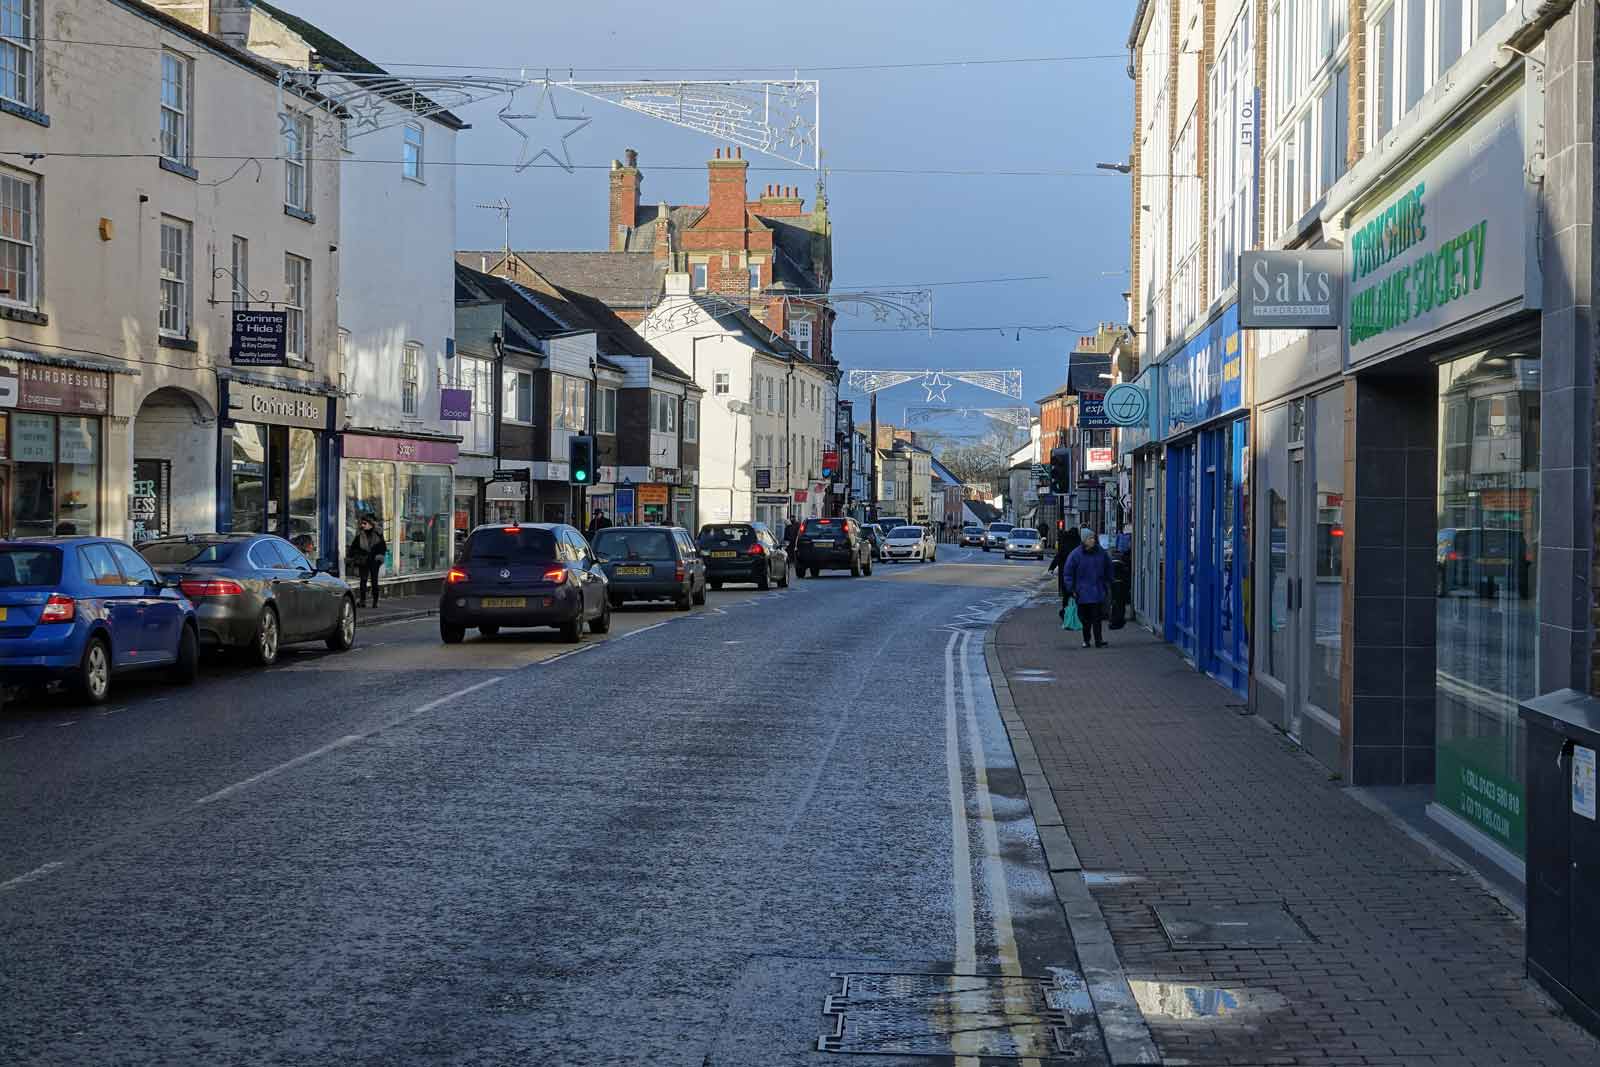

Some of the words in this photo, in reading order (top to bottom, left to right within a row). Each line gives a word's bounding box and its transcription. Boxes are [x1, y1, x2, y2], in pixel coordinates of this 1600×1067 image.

[1241, 100, 1252, 118] TO
[1241, 121, 1252, 146] LET
[1352, 181, 1426, 282] YORKSHIRE
[1252, 259, 1330, 302] Saks
[1350, 264, 1410, 346] BUILDING
[1412, 219, 1487, 318] SOCIETY
[236, 313, 283, 323] Corinne
[1254, 305, 1329, 315] HAIRDRESSING
[247, 324, 273, 333] Hide
[23, 367, 108, 389] HAIRDRESSING
[252, 394, 295, 416] Corinne
[295, 400, 319, 420] Hide
